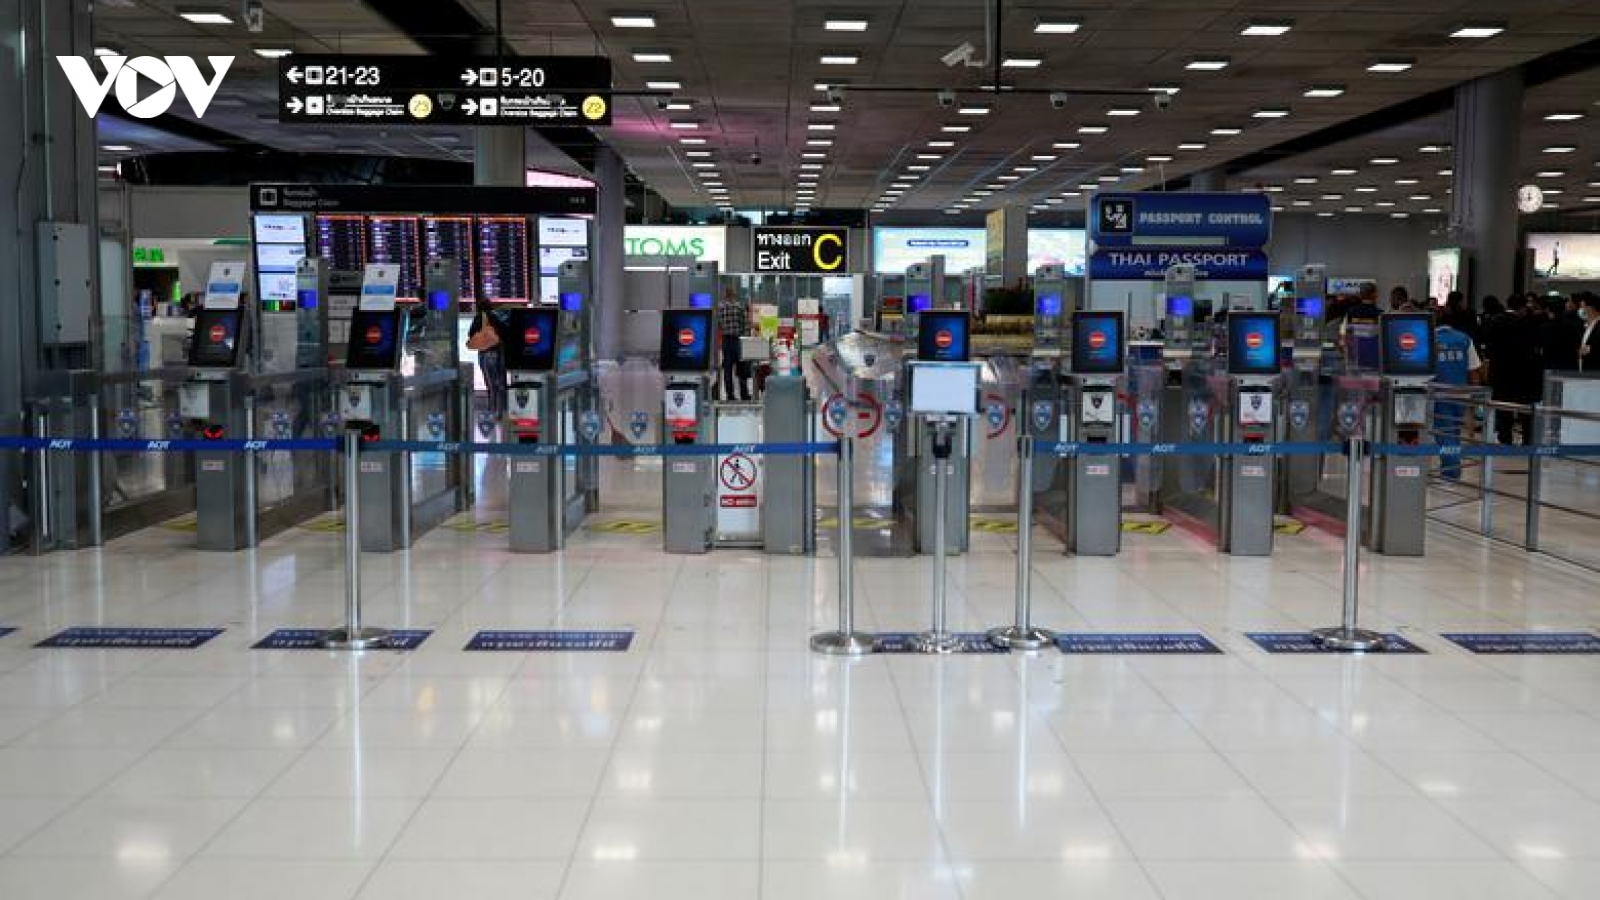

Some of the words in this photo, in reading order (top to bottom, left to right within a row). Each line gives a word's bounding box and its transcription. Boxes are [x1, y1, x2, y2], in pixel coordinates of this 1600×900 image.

[325, 66, 381, 85] 21-23
[501, 68, 545, 87] 5-20
[1138, 212, 1203, 225] PASSPORT
[1207, 212, 1264, 225] CONTROL
[813, 233, 843, 270] C
[758, 251, 791, 270] Exit
[1109, 252, 1151, 267] THAI
[1158, 252, 1249, 267] PASSPORT
[50, 441, 73, 450] AOT
[148, 441, 171, 450] AOT
[244, 441, 268, 450] AOT
[1054, 444, 1078, 452] AOT
[1153, 444, 1176, 453] AOT
[1249, 445, 1272, 453] AOT
